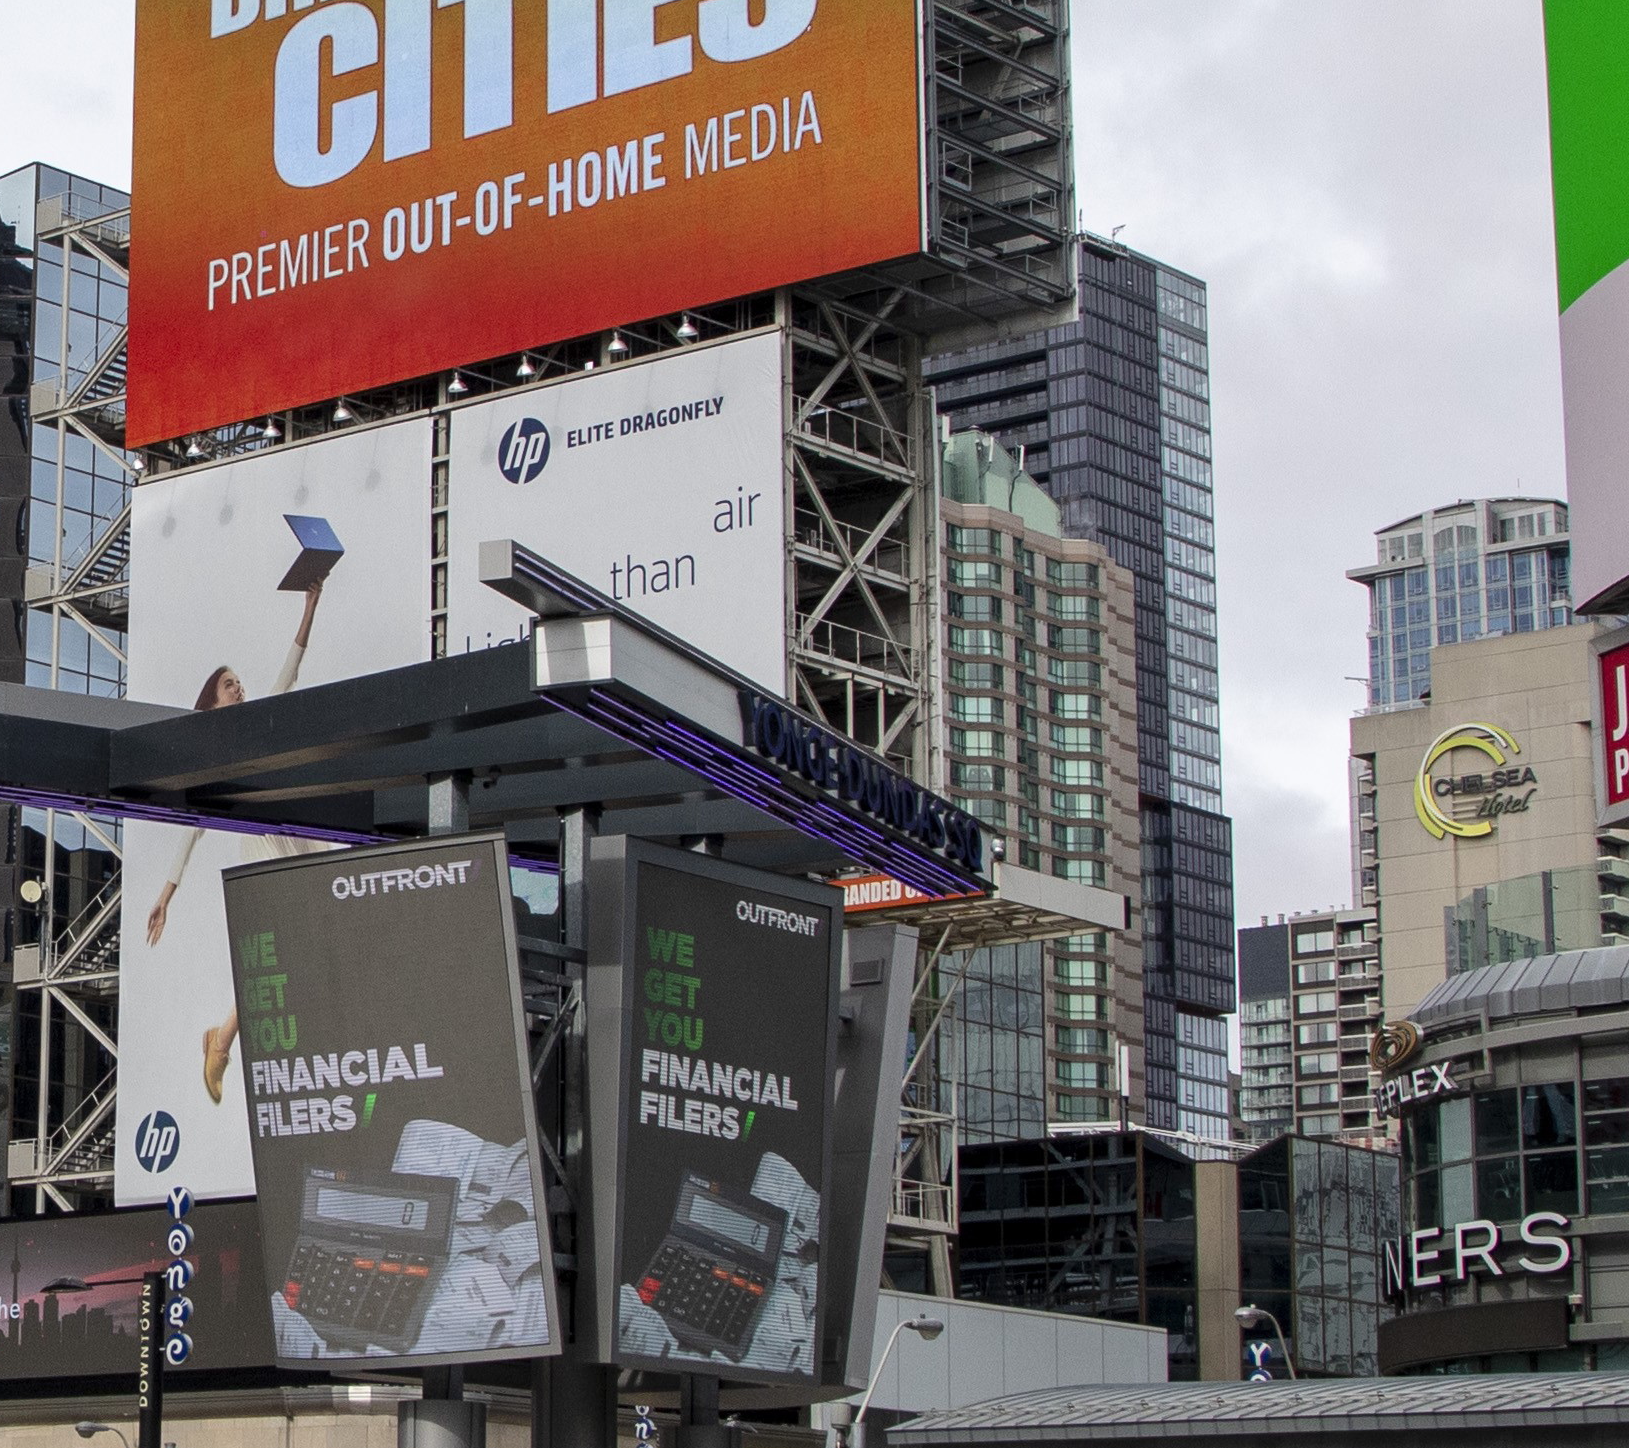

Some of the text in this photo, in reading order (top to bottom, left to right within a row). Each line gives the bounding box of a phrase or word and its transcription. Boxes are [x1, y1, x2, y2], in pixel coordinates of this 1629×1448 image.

[205, 90, 825, 313] PREMIER OUT-OF-HOME MEDIA
[566, 396, 725, 449] ELITE DRAGONFLY
[499, 417, 551, 484] hp
[713, 486, 762, 533] air
[610, 553, 697, 601] than
[1433, 766, 1537, 797] CHELSEA
[1477, 788, 1538, 819] Hotel
[330, 859, 471, 900] OUTFRONT
[735, 900, 820, 938] OUTFRONT
[240, 931, 278, 969] WE
[645, 926, 696, 969] WE
[241, 974, 288, 1012] GET
[643, 968, 702, 1011] GET
[246, 1015, 299, 1054] YOU
[643, 1008, 704, 1052] YOU
[250, 1043, 444, 1094] FINANCIAL
[640, 1048, 799, 1112] FINANCIAL
[136, 1110, 180, 1175] hp
[166, 1186, 195, 1364] Yonge
[138, 1282, 151, 1408] DOWNTOWN
